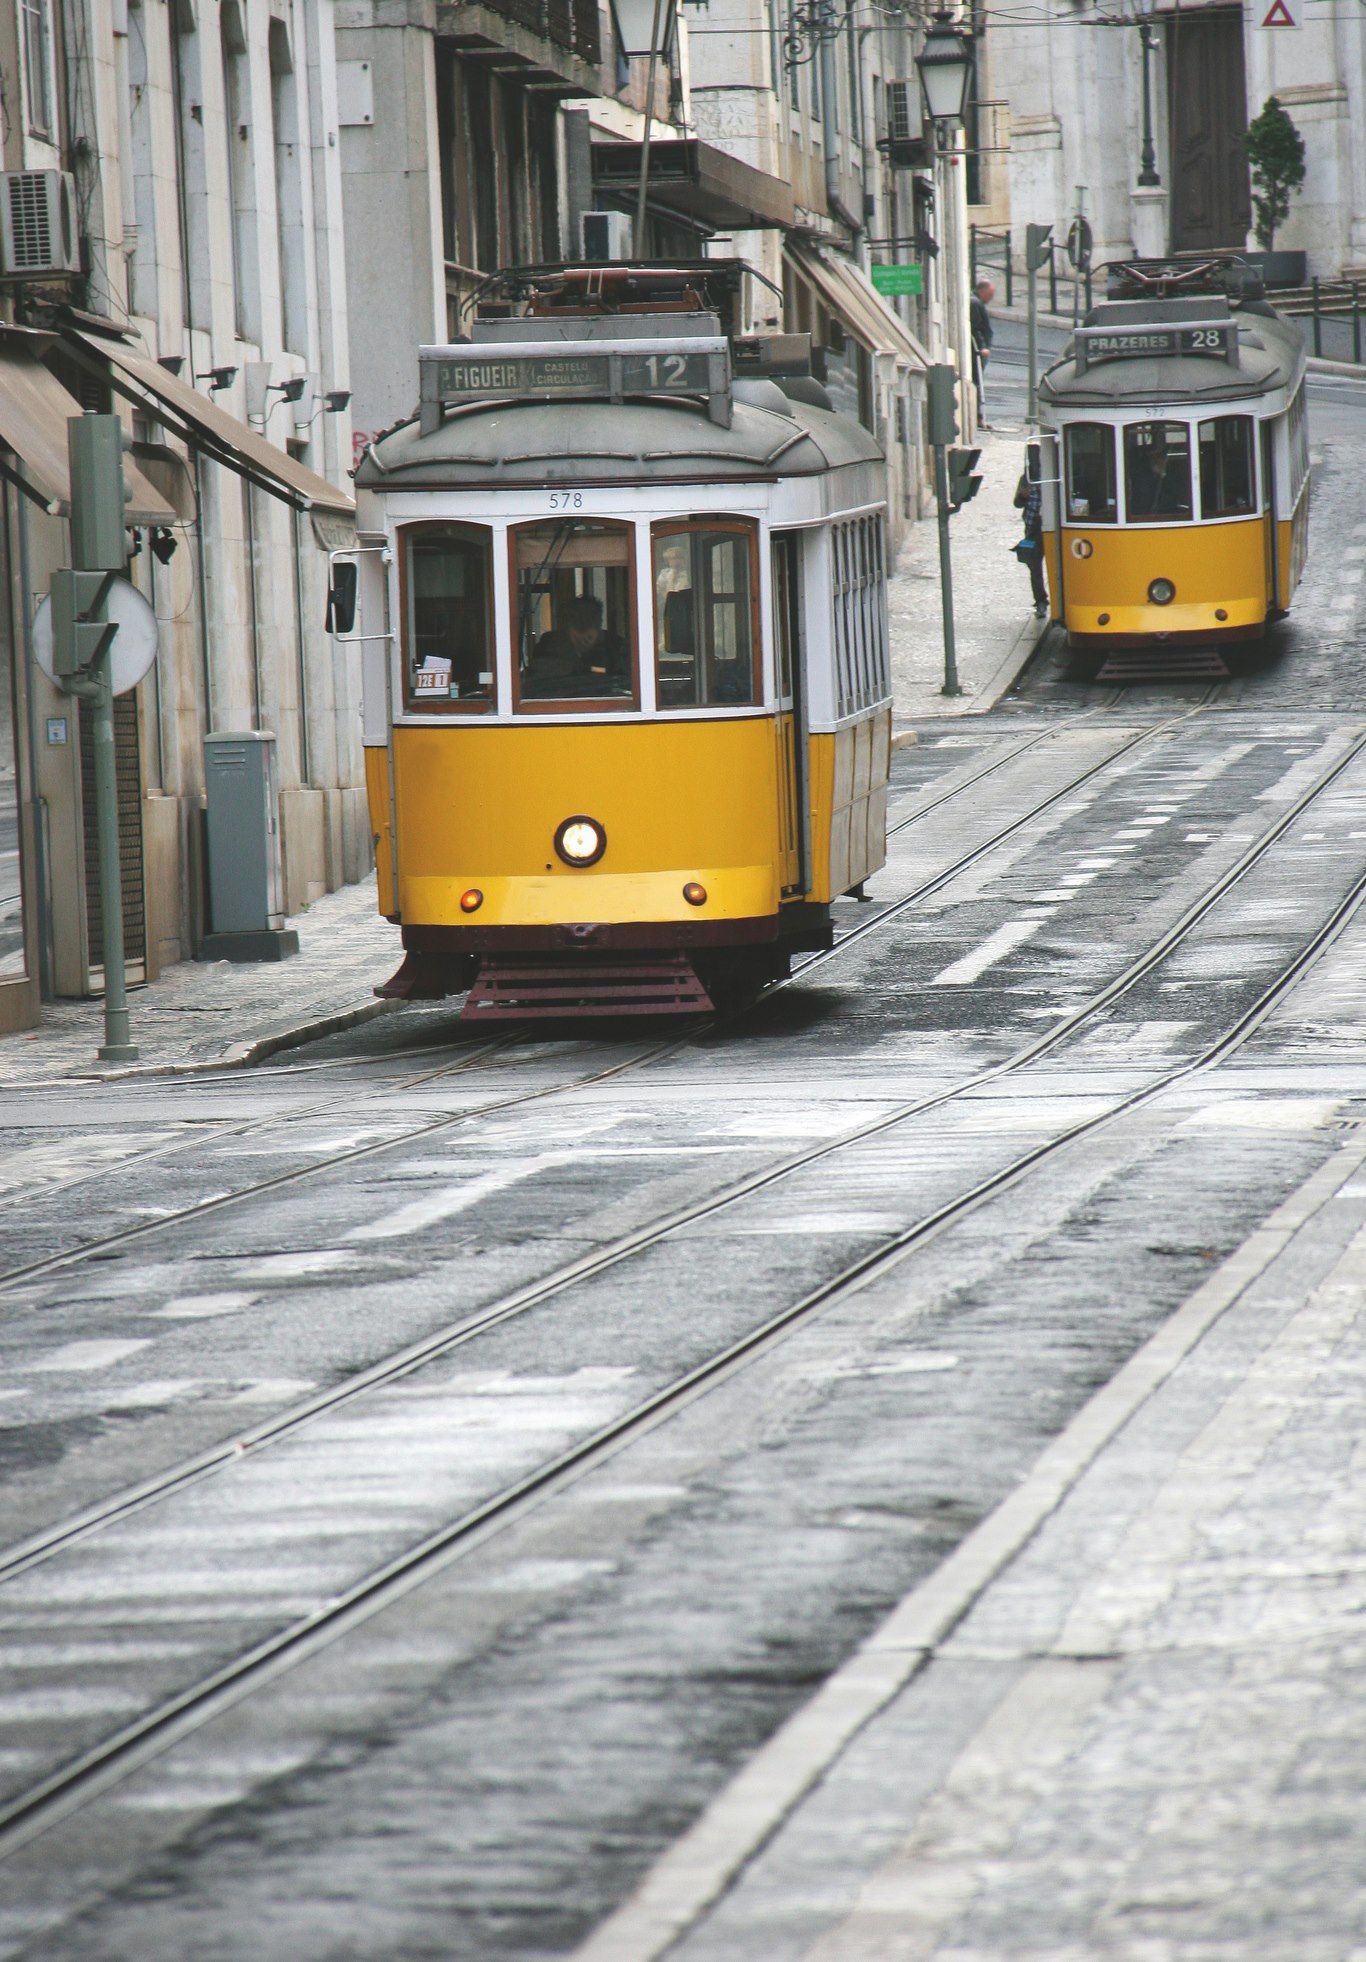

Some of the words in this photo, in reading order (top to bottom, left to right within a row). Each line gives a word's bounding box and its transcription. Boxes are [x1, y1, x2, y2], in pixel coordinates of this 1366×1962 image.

[1087, 335, 1170, 351] PRAZERES
[1191, 329, 1220, 348] 28
[454, 364, 518, 389] FIGUEIR
[645, 354, 689, 388] 12
[549, 492, 583, 509] 578
